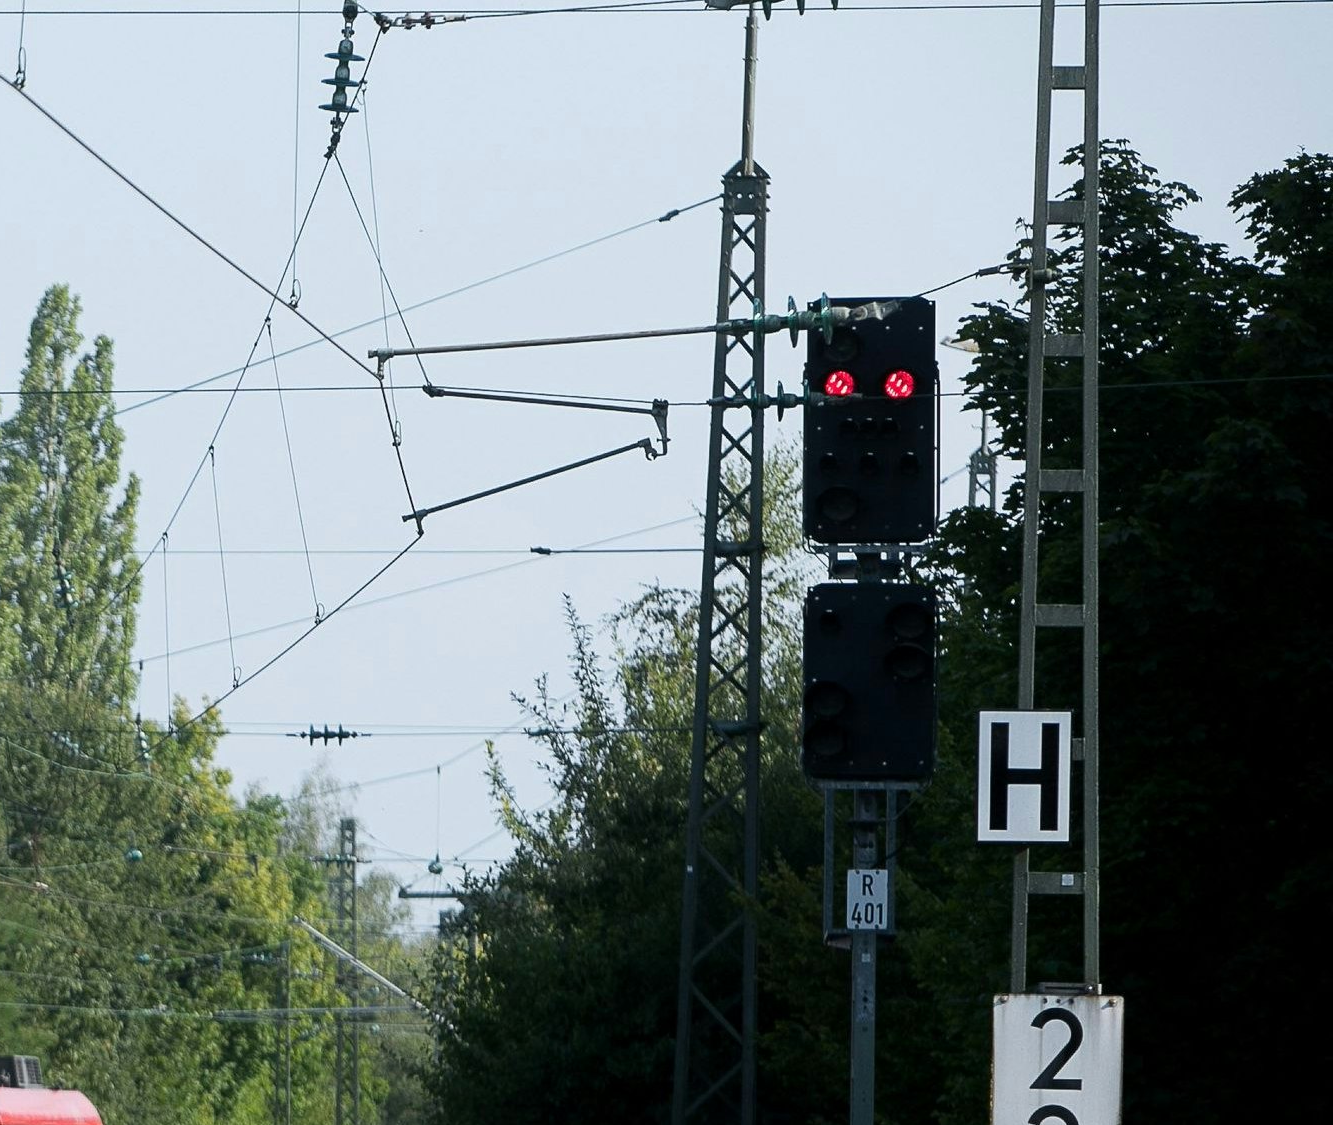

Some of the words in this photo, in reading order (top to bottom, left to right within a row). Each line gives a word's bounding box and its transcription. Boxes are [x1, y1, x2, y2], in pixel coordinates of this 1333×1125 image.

[989, 721, 1060, 832] H
[862, 874, 874, 896] R
[851, 902, 883, 925] 401
[1029, 1007, 1084, 1091] 2
